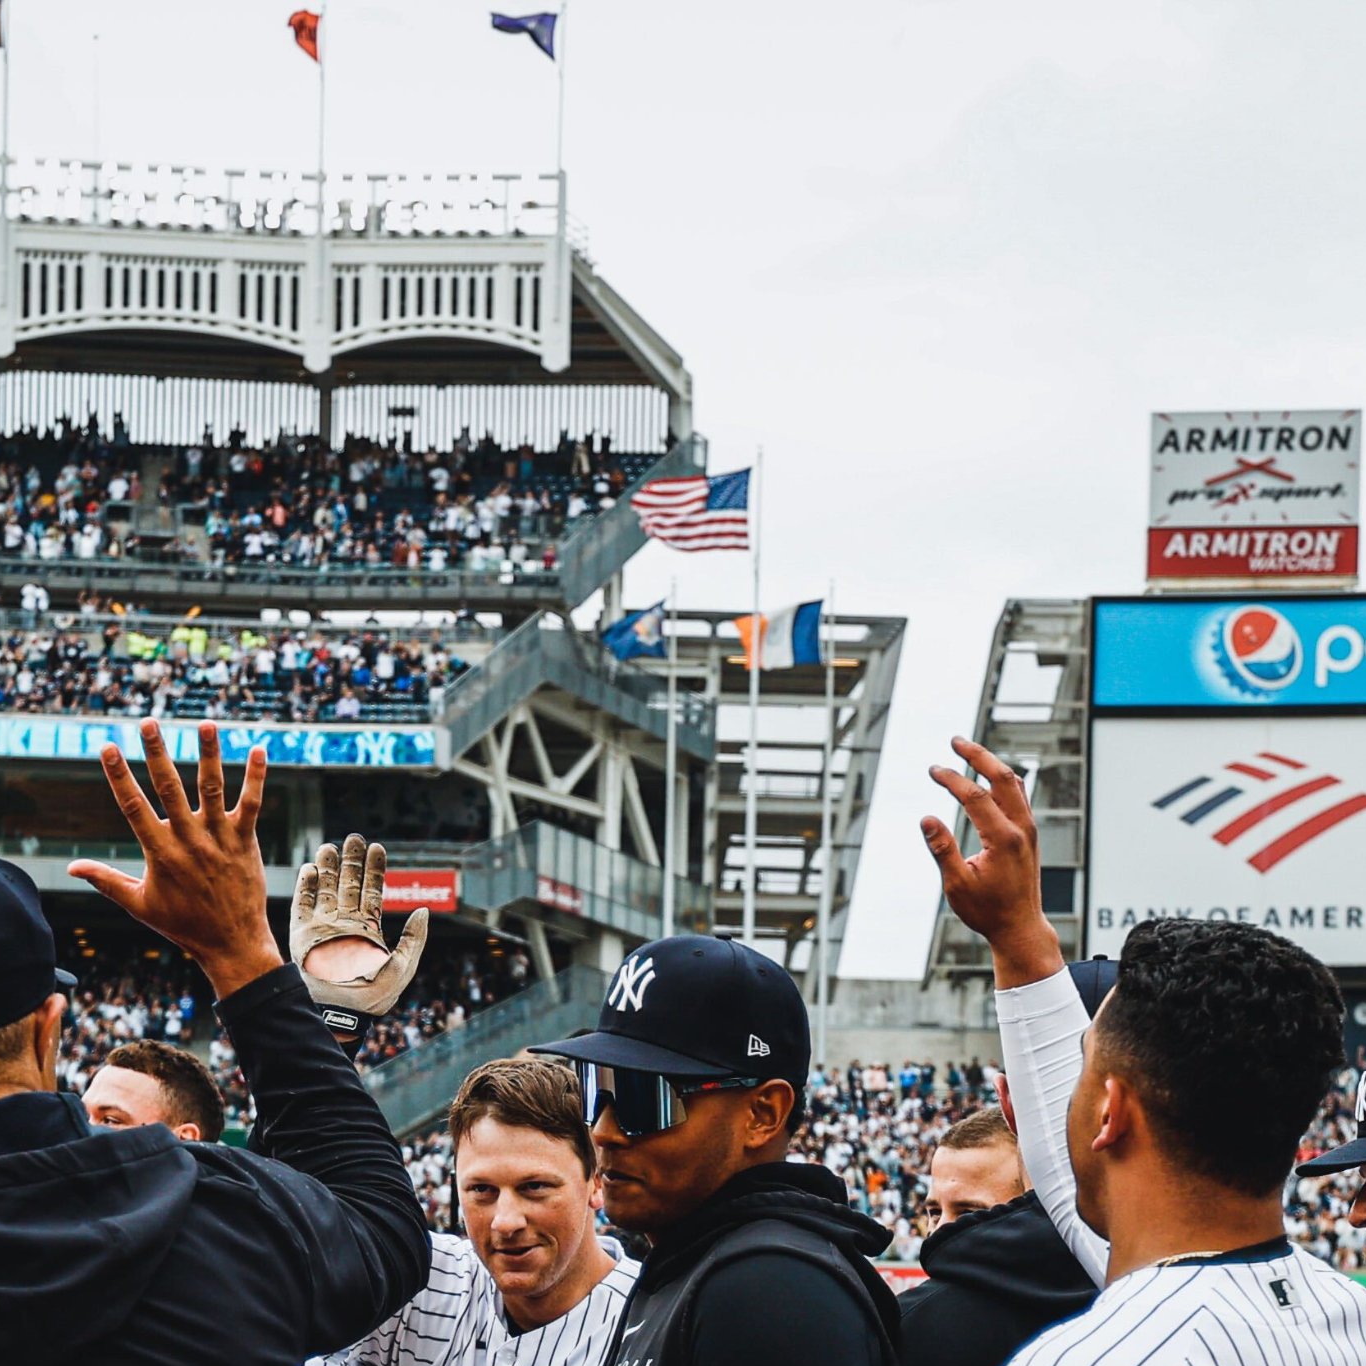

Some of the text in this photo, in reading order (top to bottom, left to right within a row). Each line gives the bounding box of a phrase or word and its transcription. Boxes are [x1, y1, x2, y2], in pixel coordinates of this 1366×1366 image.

[1158, 426, 1352, 453] ARMITRON
[1163, 530, 1341, 558] ARMITRON
[1249, 556, 1335, 572] WATCHES
[608, 955, 656, 1012] NY
